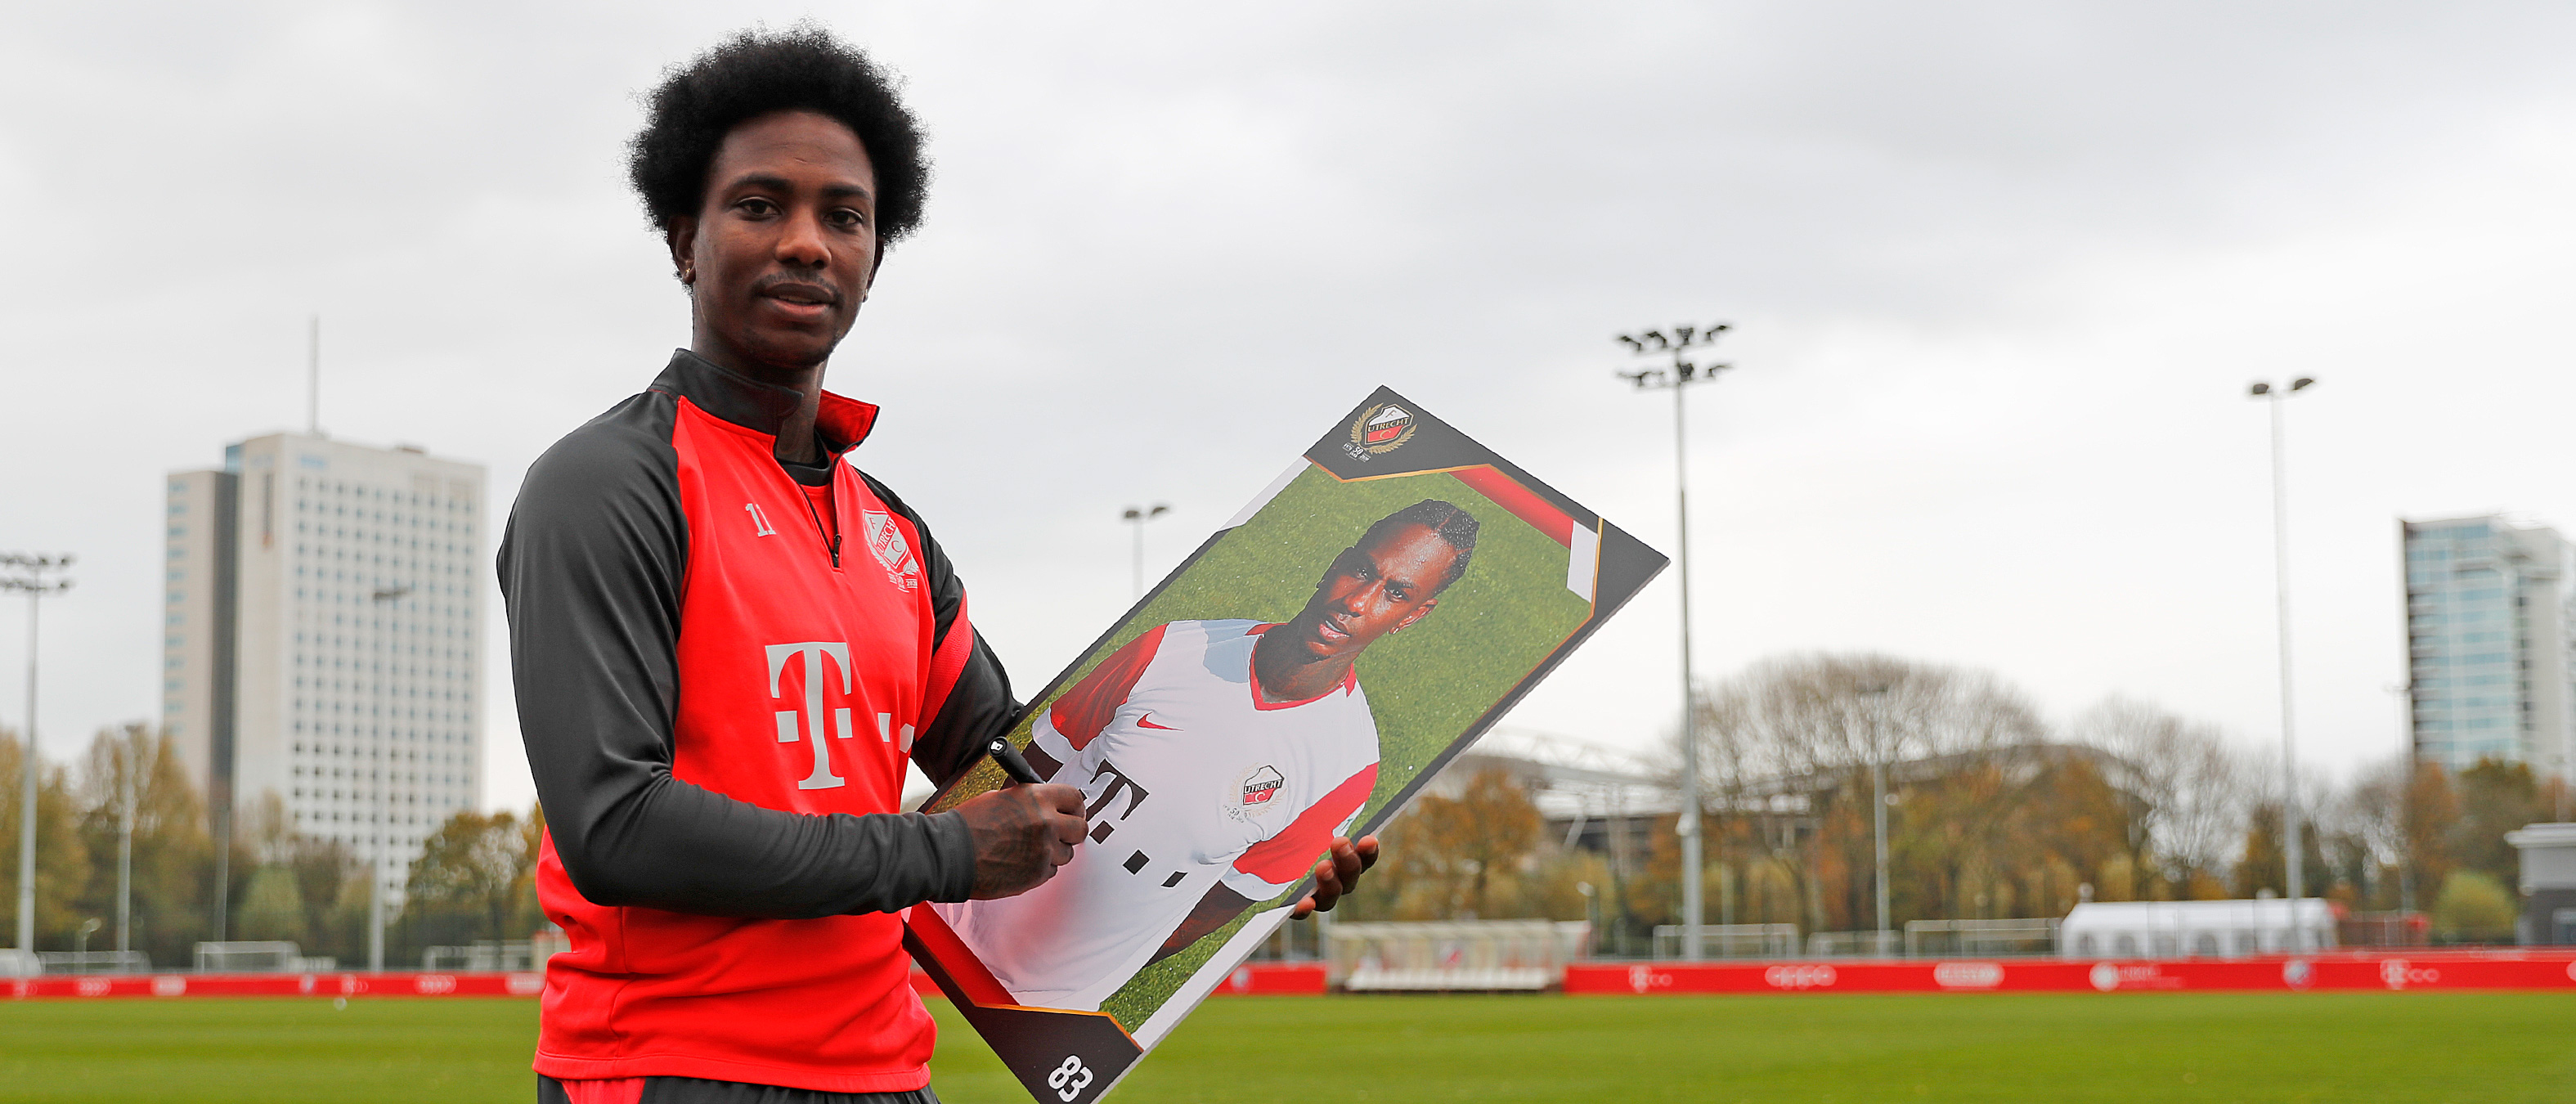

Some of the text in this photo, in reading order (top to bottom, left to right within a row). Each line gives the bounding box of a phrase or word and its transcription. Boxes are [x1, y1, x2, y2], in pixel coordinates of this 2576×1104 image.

[1367, 418, 1410, 433] UTRECHT
[1380, 430, 1392, 440] C
[745, 503, 777, 537] 11
[891, 540, 903, 553] C
[765, 641, 853, 790] T
[1244, 779, 1282, 794] UTRECHT
[1254, 791, 1266, 802] C
[1048, 1055, 1093, 1102] 83
